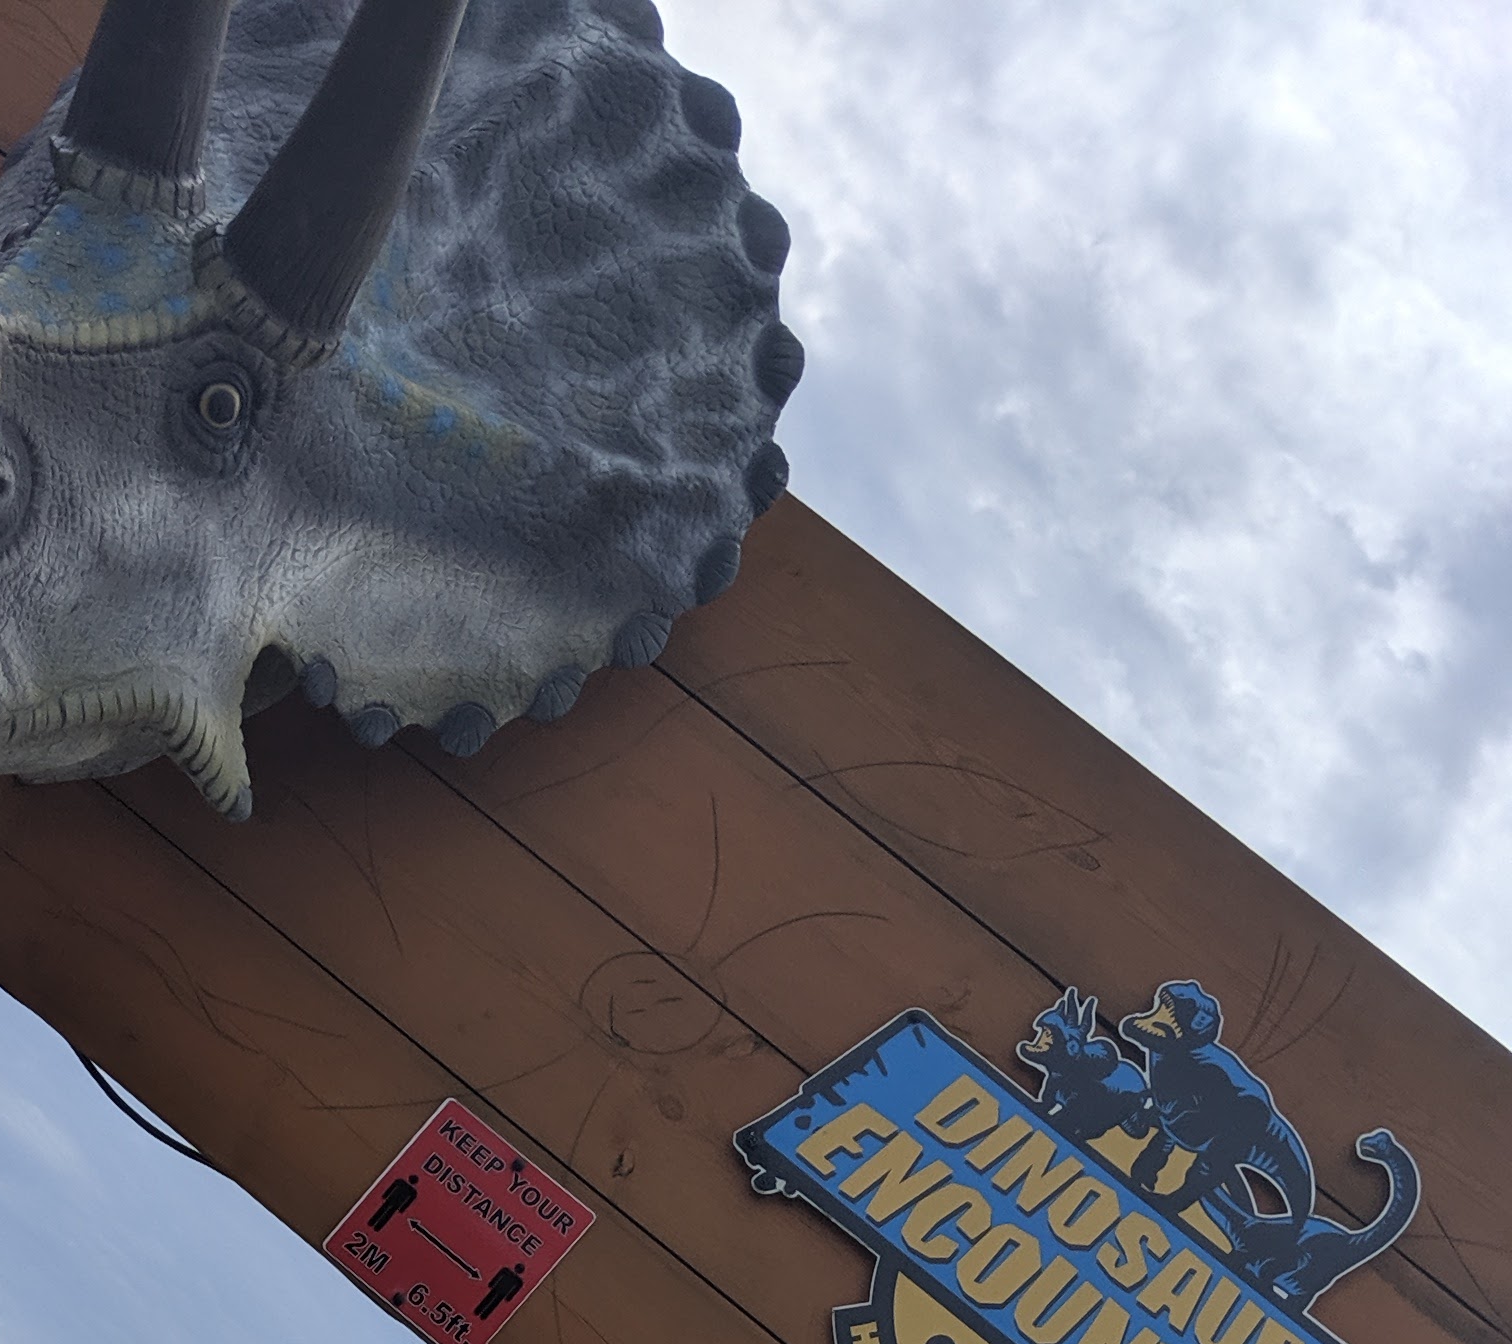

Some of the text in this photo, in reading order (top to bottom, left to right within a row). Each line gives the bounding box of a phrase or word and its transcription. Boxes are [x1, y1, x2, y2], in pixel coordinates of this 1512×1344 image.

[421, 1152, 543, 1258] DISTANCE
[438, 1119, 576, 1236] KEEP YOUR
[343, 1231, 392, 1276] 2M
